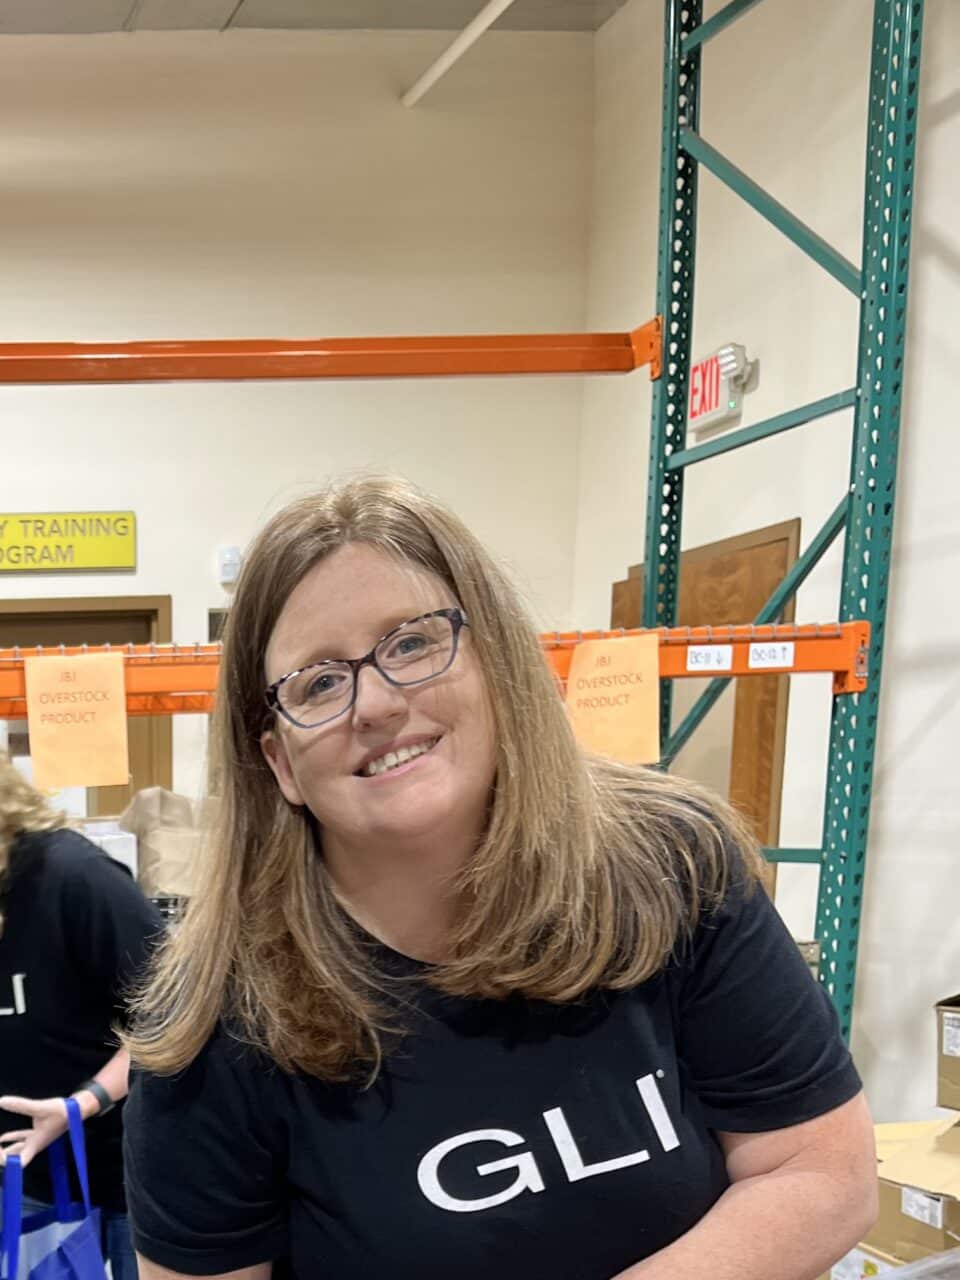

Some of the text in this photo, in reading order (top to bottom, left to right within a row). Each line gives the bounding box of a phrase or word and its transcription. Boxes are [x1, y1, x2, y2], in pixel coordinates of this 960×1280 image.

[18, 517, 130, 538] TRAINING
[575, 671, 644, 691] OVERSTOCK
[38, 689, 112, 705] OVERSTOCK
[575, 693, 631, 710] PRODUCT
[39, 710, 97, 726] PRODUCT
[416, 1072, 681, 1213] GLI
